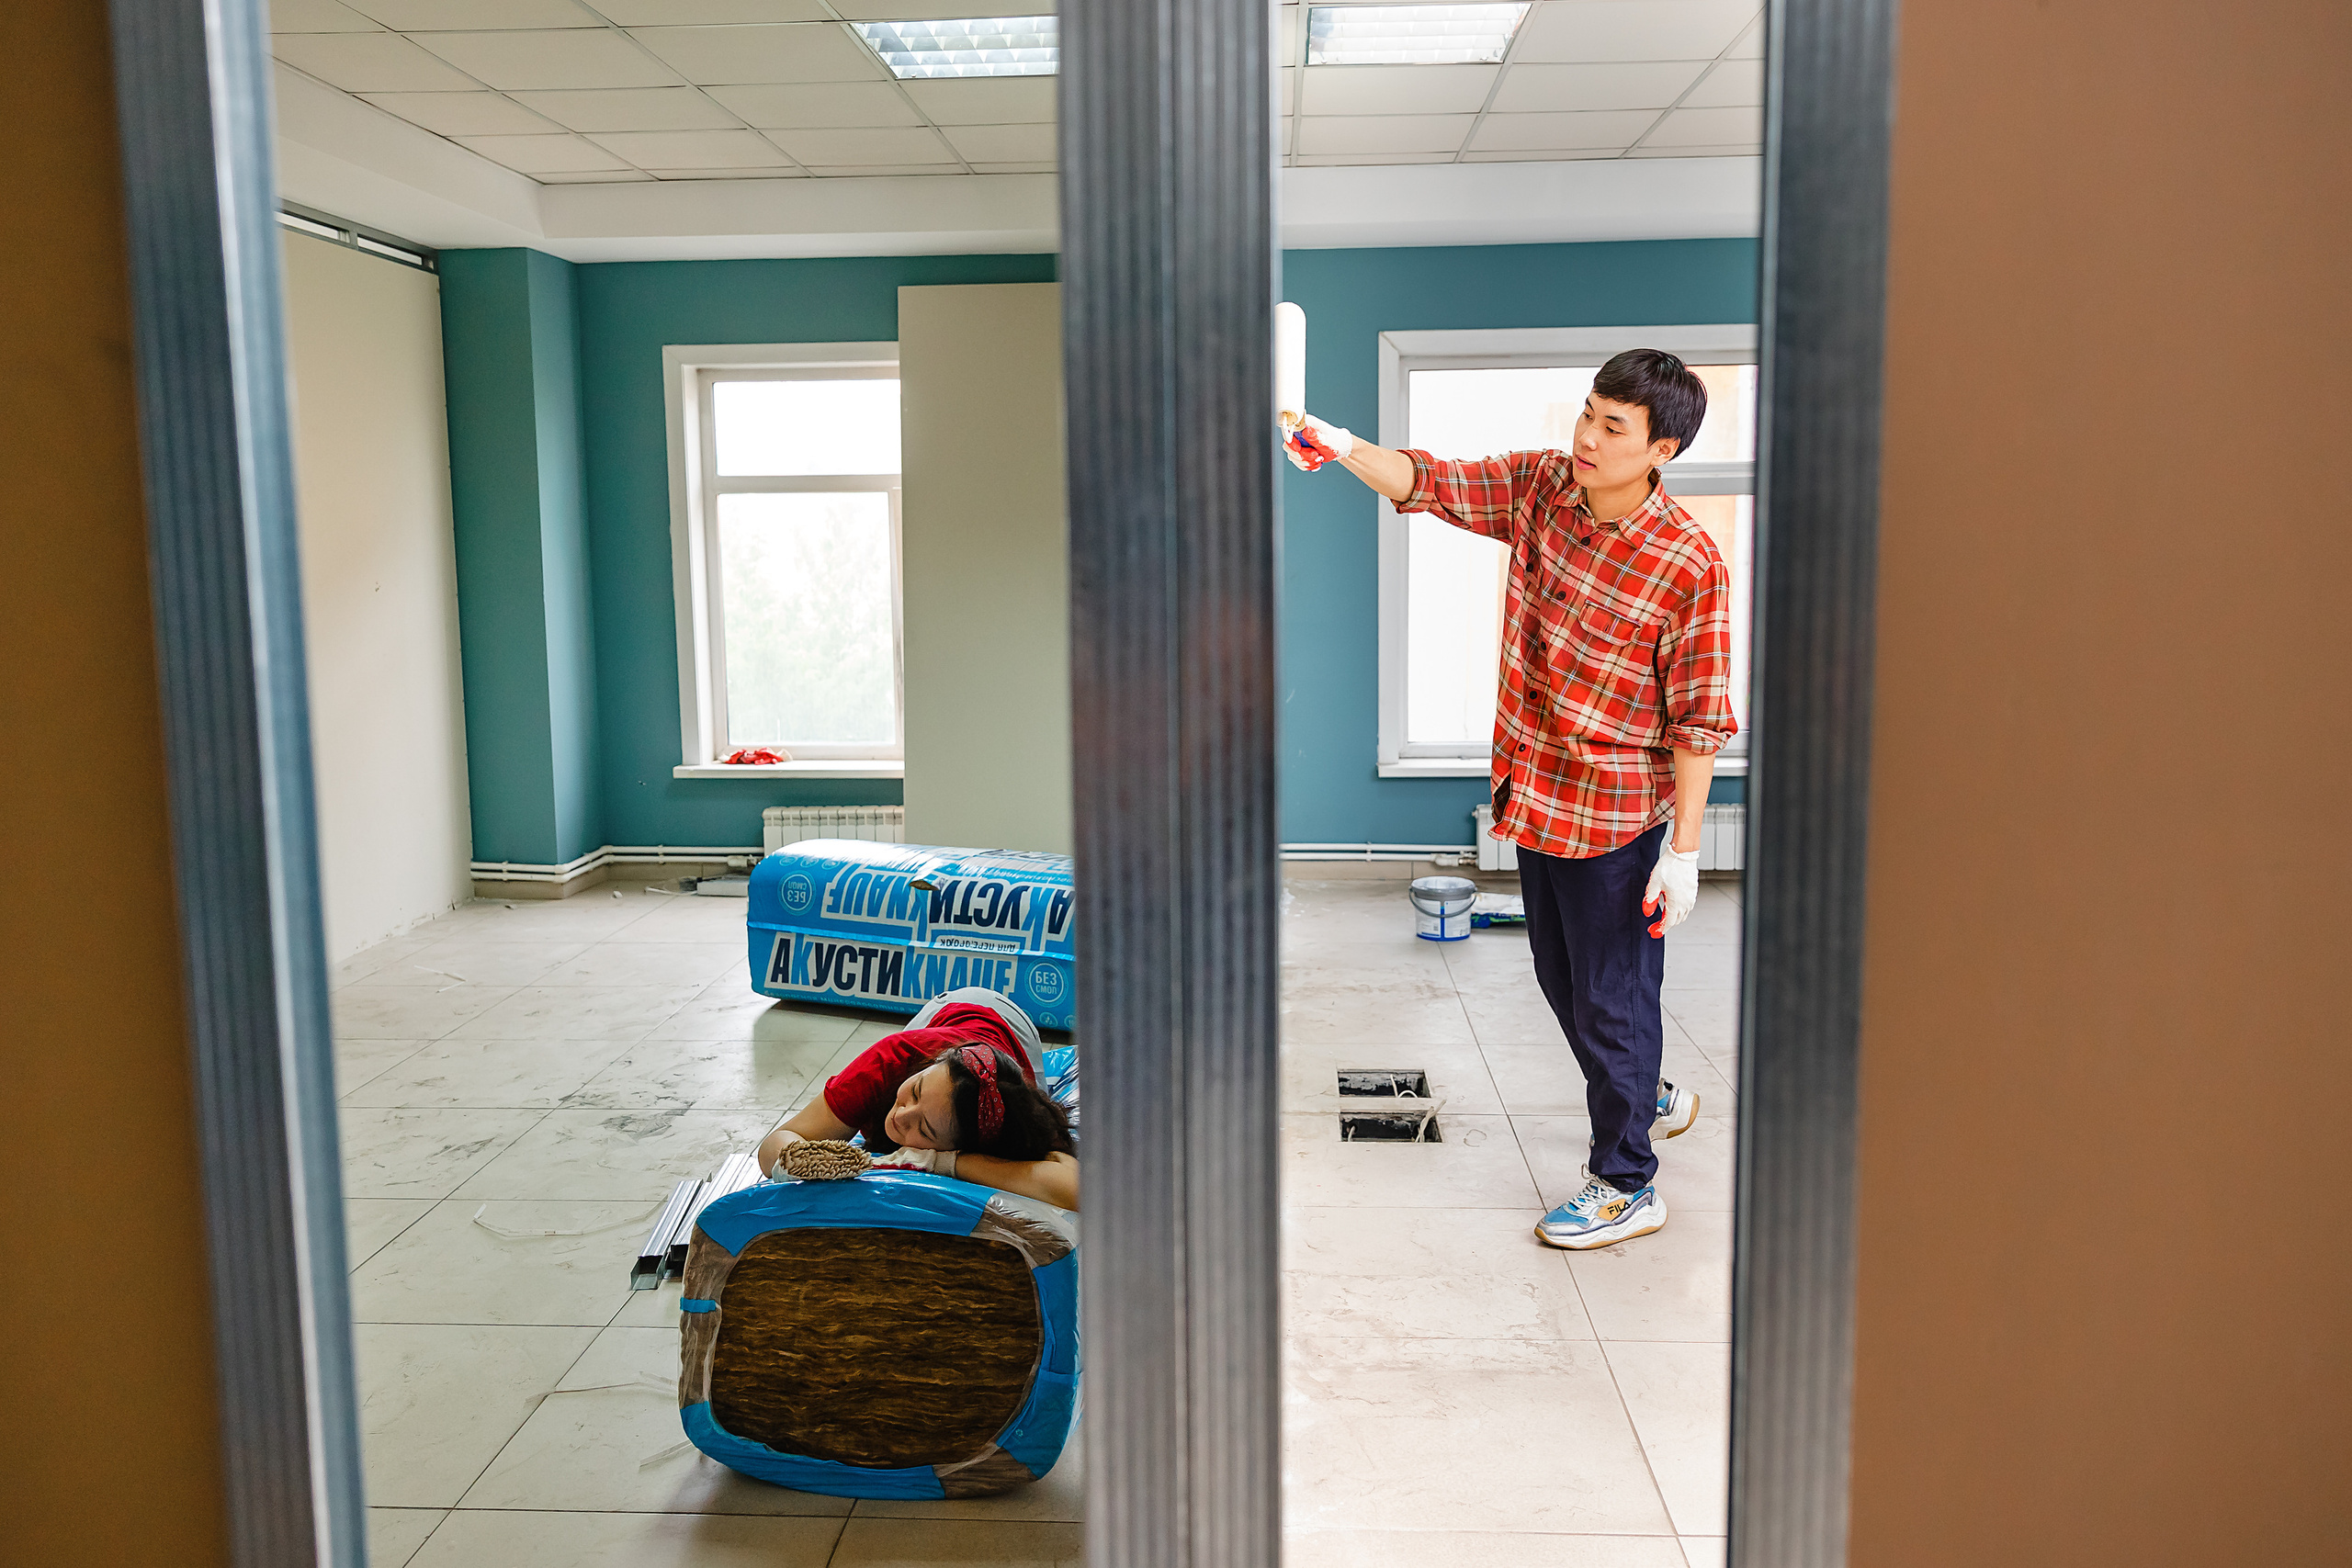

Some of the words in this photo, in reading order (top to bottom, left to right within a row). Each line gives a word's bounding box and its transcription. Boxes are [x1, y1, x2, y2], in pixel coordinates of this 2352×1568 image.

[787, 889, 807, 903] БЕЗ
[997, 943, 1016, 953] ДЛЯ
[1035, 971, 1057, 986] БЕЗ
[1035, 985, 1057, 995] СМОЛ
[1607, 1201, 1631, 1215] FILA
